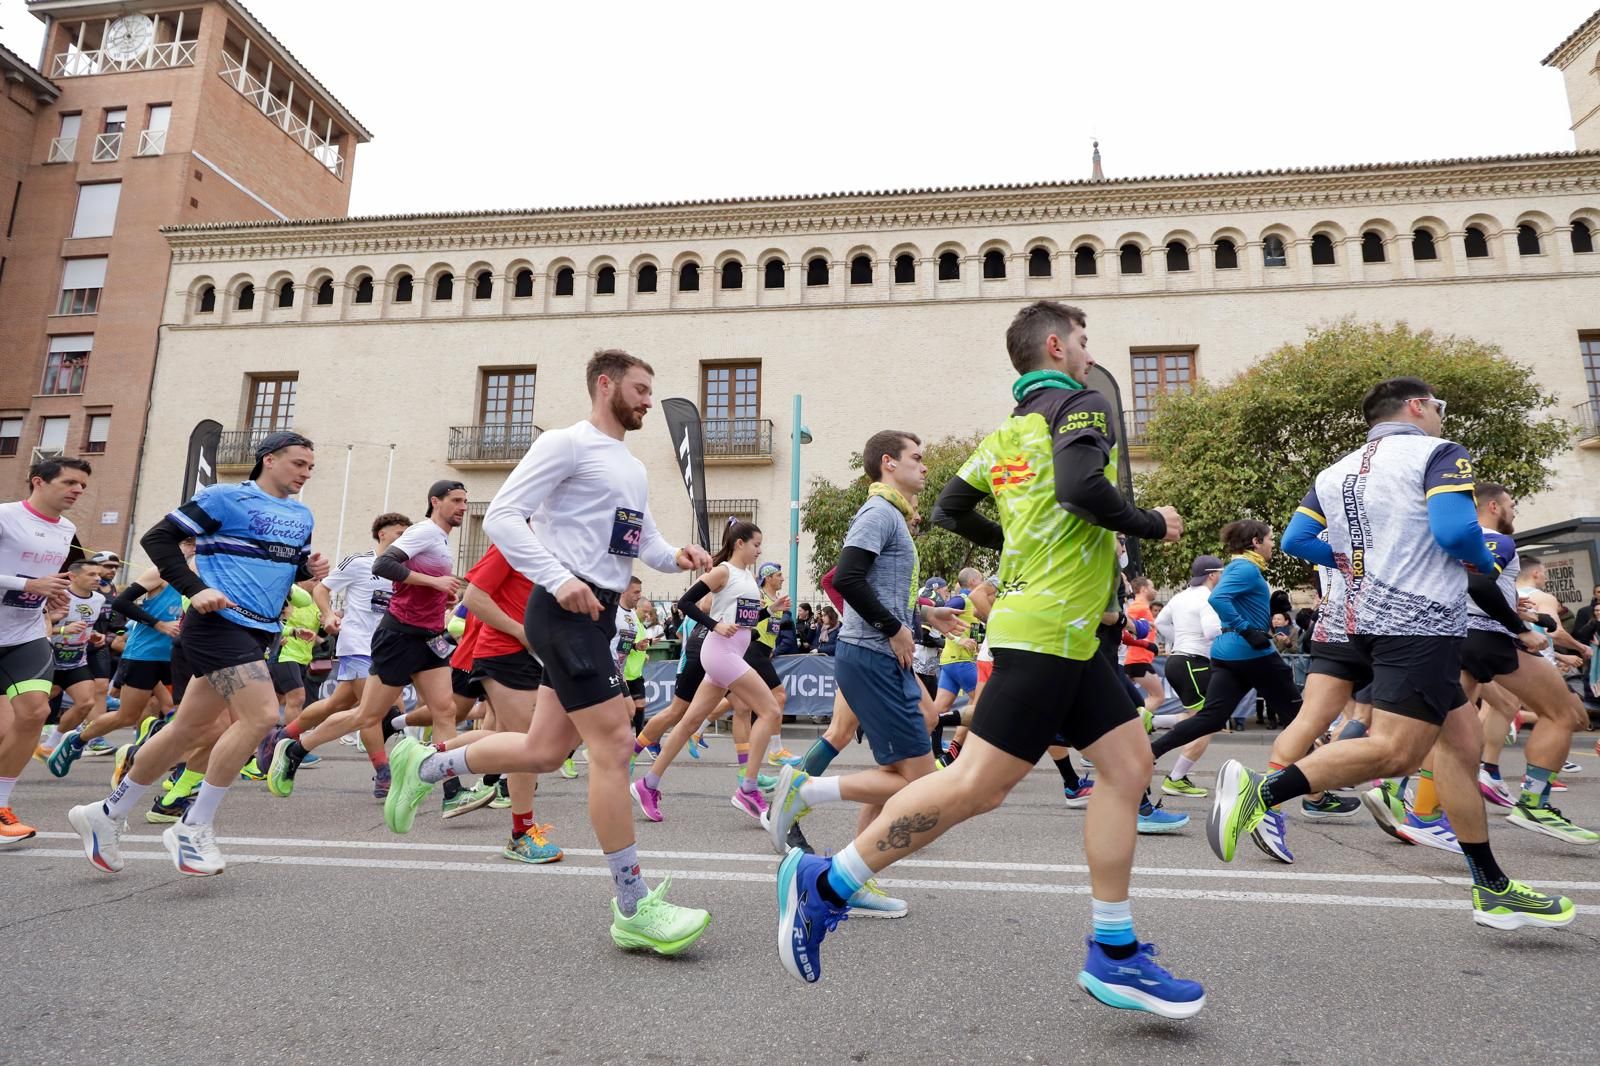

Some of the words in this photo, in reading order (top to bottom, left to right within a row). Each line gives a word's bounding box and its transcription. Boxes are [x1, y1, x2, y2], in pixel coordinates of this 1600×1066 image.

[1067, 411, 1089, 422] NO
[1343, 474, 1358, 518] MARATÓN
[1350, 520, 1363, 548] MEDIA
[1361, 512, 1373, 549] IBERCAJA
[1353, 549, 1364, 577] RODI
[1548, 566, 1575, 580] MEJOR
